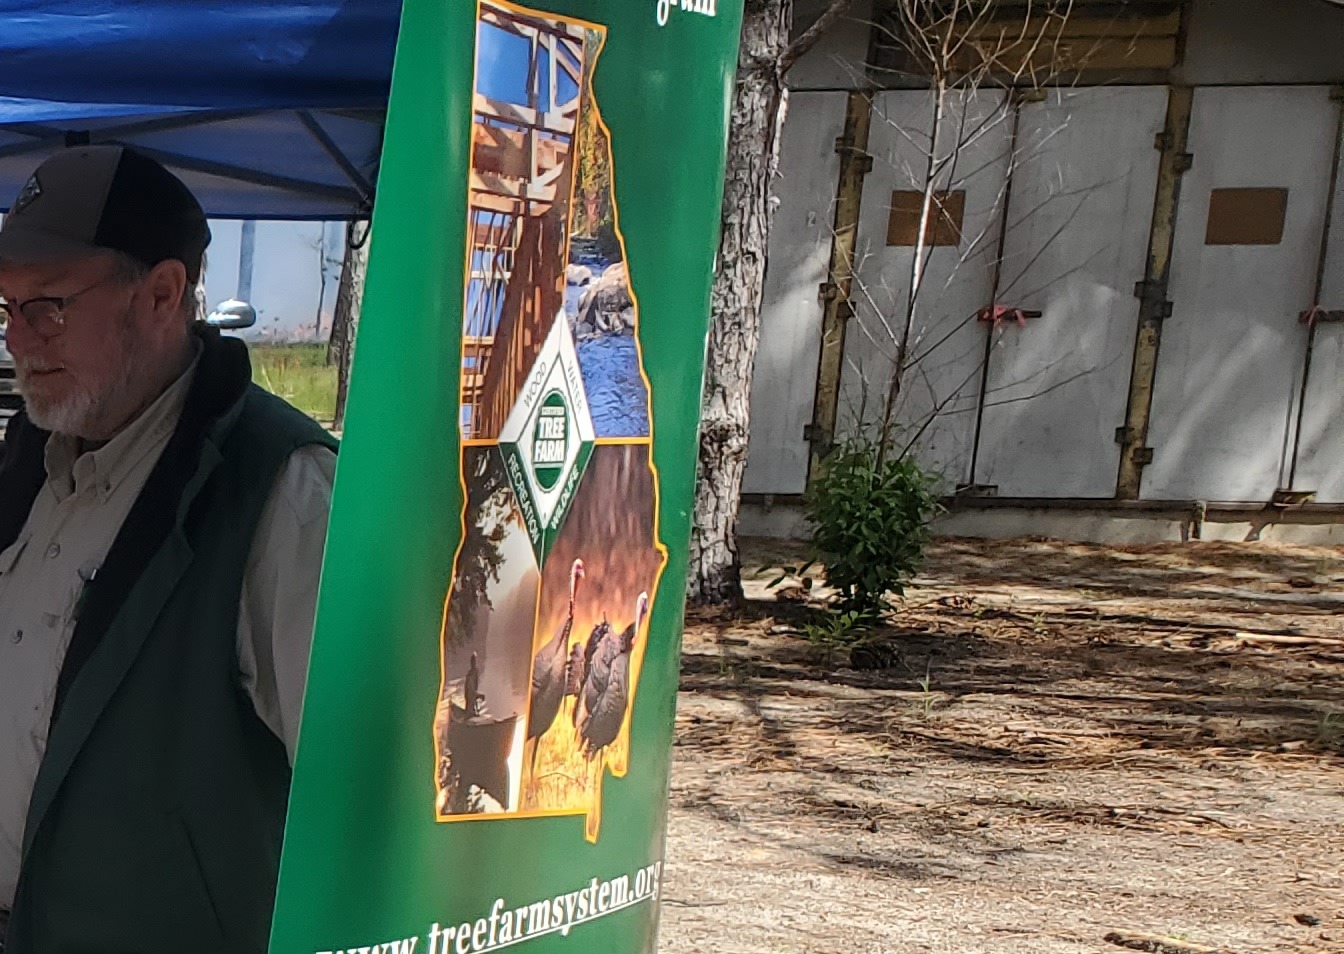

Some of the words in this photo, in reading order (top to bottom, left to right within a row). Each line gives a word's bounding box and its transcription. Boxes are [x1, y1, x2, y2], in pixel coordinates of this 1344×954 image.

[523, 361, 547, 409] WOOD
[534, 439, 566, 463] FARM
[538, 416, 566, 440] TREE
[507, 452, 541, 546] RECREATION
[550, 463, 581, 531] WILDLIFE
